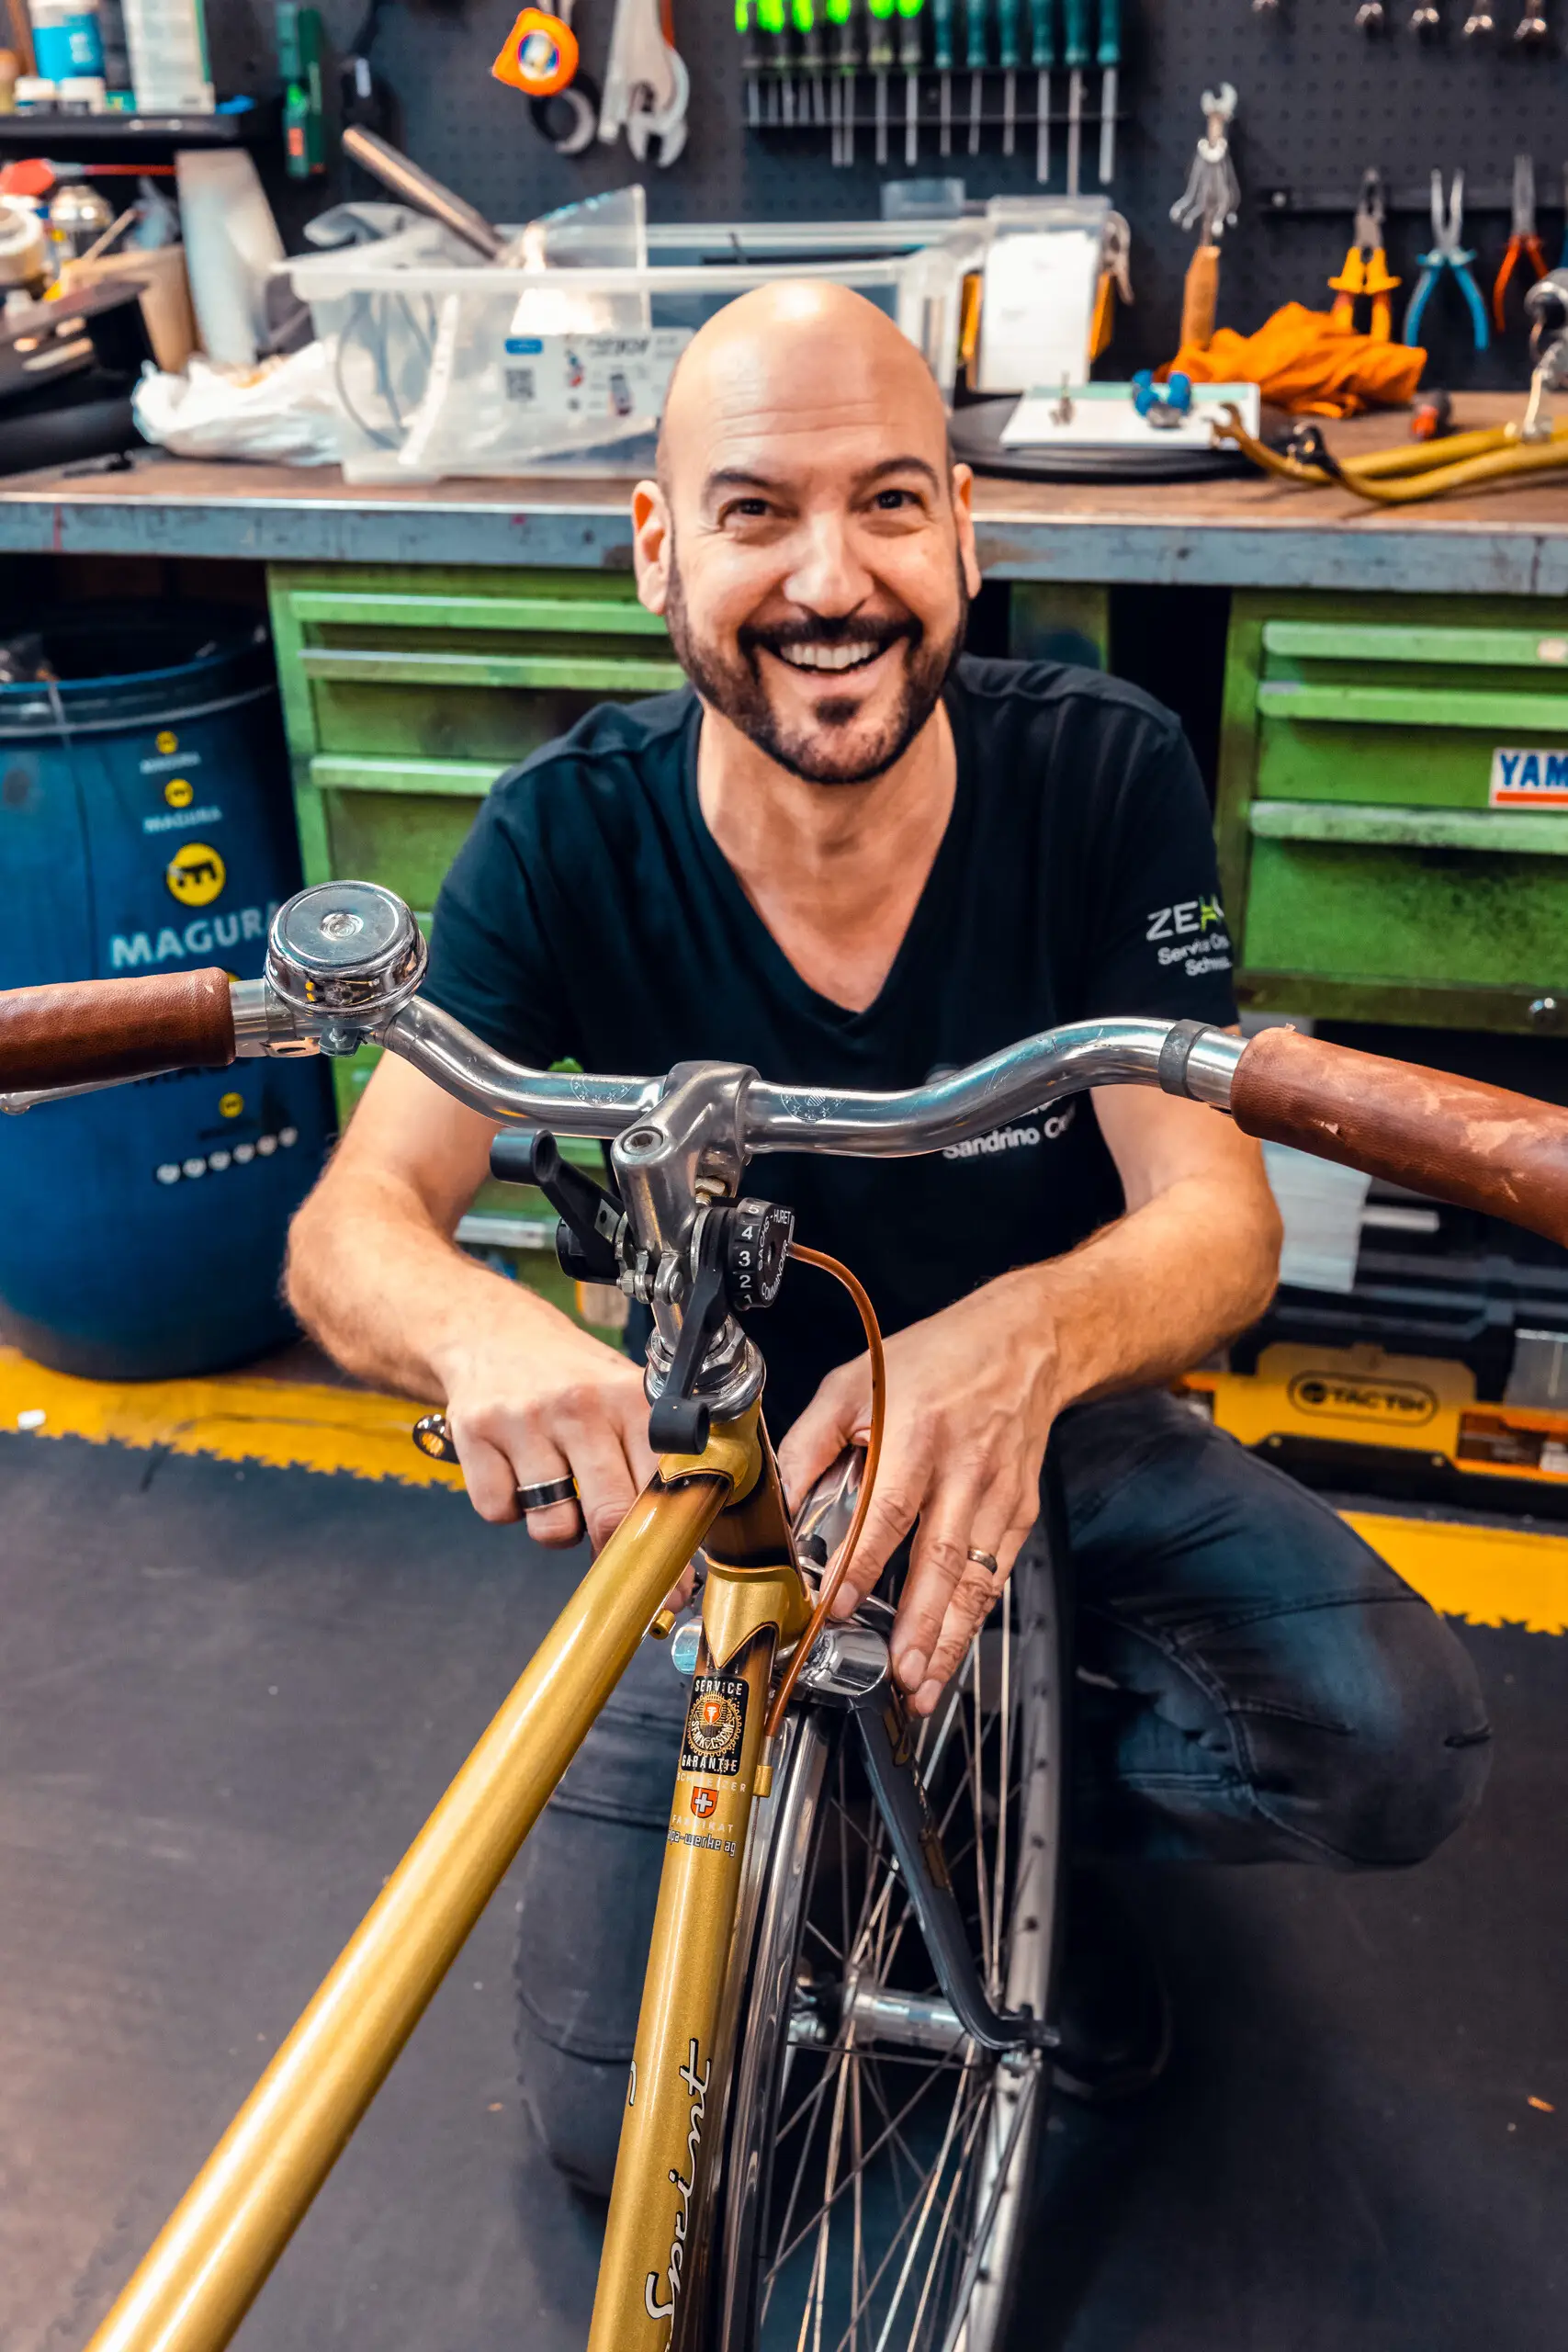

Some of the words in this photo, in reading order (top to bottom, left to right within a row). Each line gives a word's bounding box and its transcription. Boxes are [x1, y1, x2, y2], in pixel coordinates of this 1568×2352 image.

[942, 1126, 1041, 1159] Sandrino
[748, 1204, 760, 1215] 5
[741, 1225, 753, 1240] 4
[738, 1250, 751, 1267] 3
[739, 1274, 752, 1288] 2
[744, 1294, 752, 1304] 1
[694, 1679, 742, 1696] SERVICE
[682, 1754, 738, 1772] GARANTIE
[676, 1771, 746, 1792] SCHEIZER
[671, 1814, 734, 1834] FABIKAT
[724, 1840, 737, 1858] ag
[645, 2038, 711, 2350] Sprint
